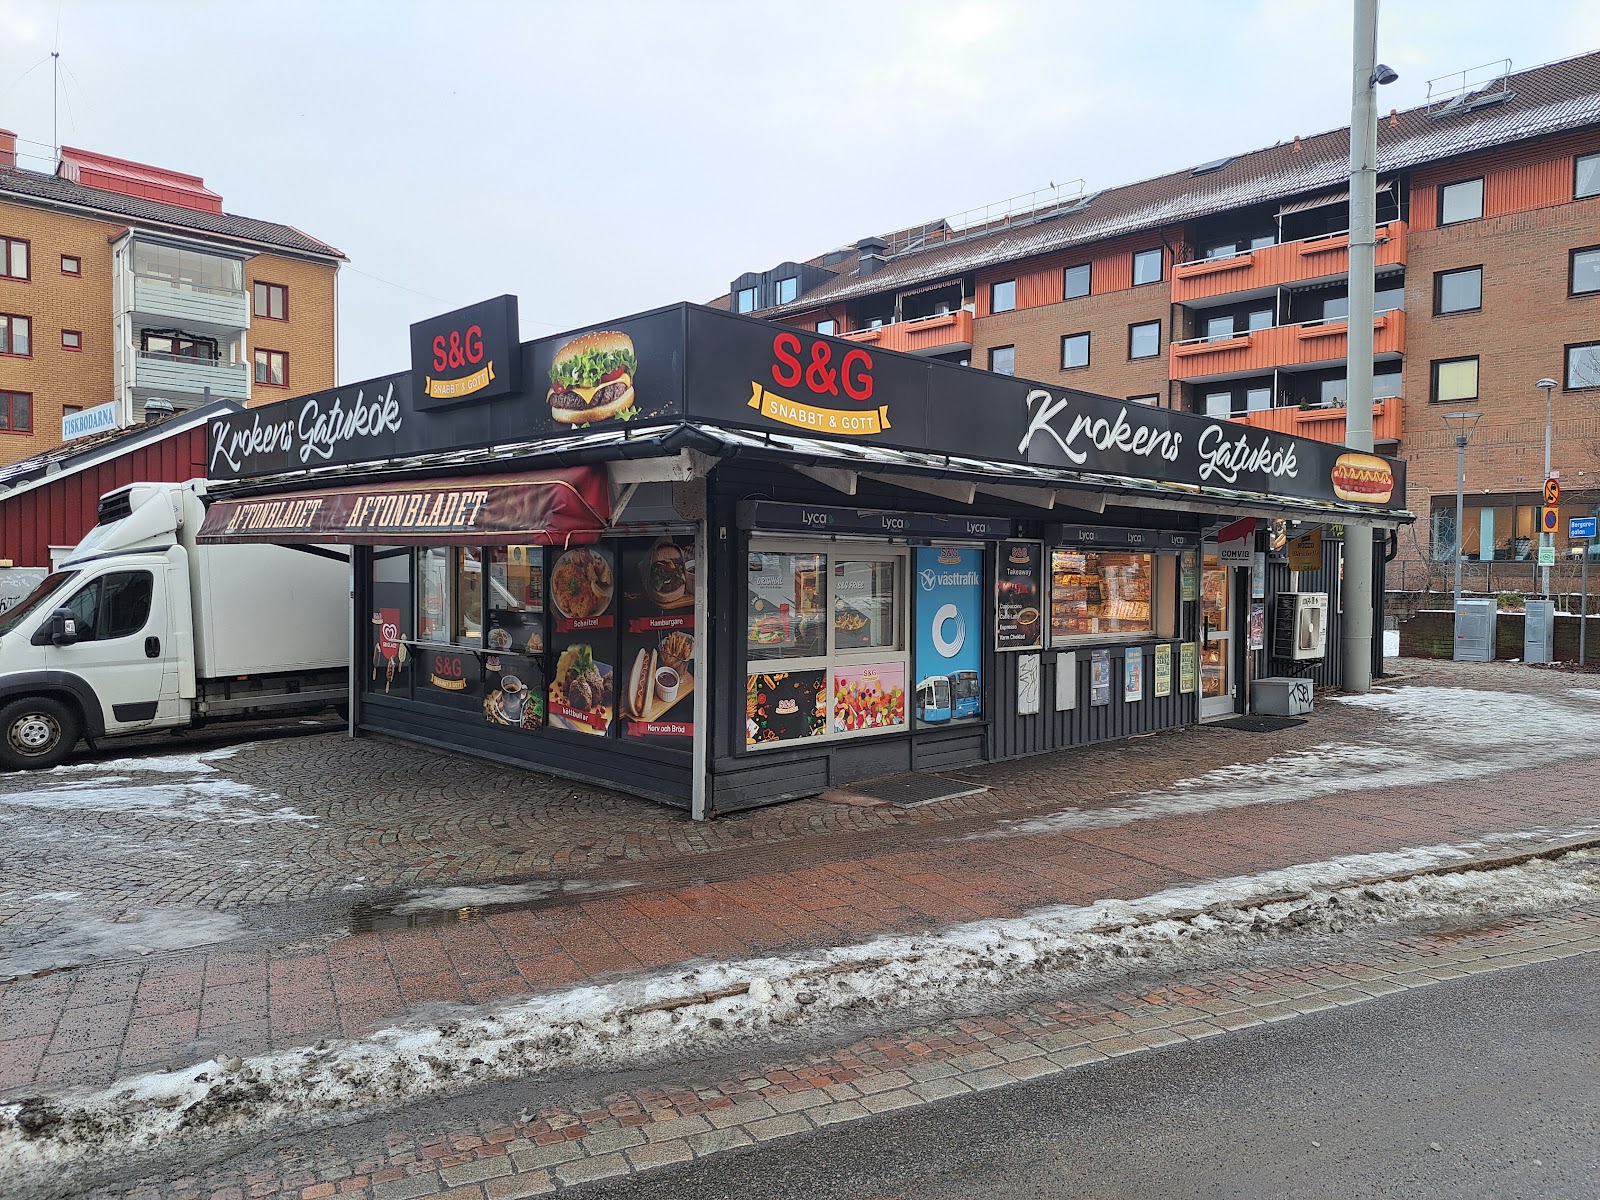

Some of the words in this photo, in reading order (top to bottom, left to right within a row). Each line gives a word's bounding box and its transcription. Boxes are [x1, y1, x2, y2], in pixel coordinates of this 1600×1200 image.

[432, 324, 484, 373] S&G
[771, 332, 873, 401] S&G
[433, 383, 459, 394] SNABBT
[461, 382, 466, 391] &
[467, 373, 486, 389] GOTT
[64, 408, 113, 436] FISKBODARNA
[770, 401, 824, 425] SNABBT
[829, 415, 837, 428] &
[841, 417, 873, 429] GOTT
[210, 413, 295, 473] Krokens
[298, 382, 403, 464] Gatukök
[1017, 388, 1184, 465] Krokens
[1198, 424, 1299, 484] Gatukök
[227, 499, 323, 530] AFTONBLADET
[346, 491, 488, 528] AFTONBLADET
[802, 510, 827, 525] Lyca
[882, 516, 904, 530] Lyca
[966, 521, 986, 533] Lyca
[1078, 530, 1094, 541] Lyca
[1127, 533, 1142, 543] Lyca
[1171, 535, 1184, 544] Lyca
[1221, 550, 1250, 558] COMVIQ
[937, 571, 979, 586] västtrafik
[1007, 567, 1032, 577] Takeaway
[573, 618, 599, 627] Schnitzel
[650, 618, 683, 628] Hamburgare
[435, 655, 462, 677] S&G
[863, 669, 877, 677] S&G
[779, 699, 796, 709] S&G
[562, 707, 588, 721] köttbullar
[647, 724, 660, 732] Korv
[672, 724, 685, 733] Bröd
